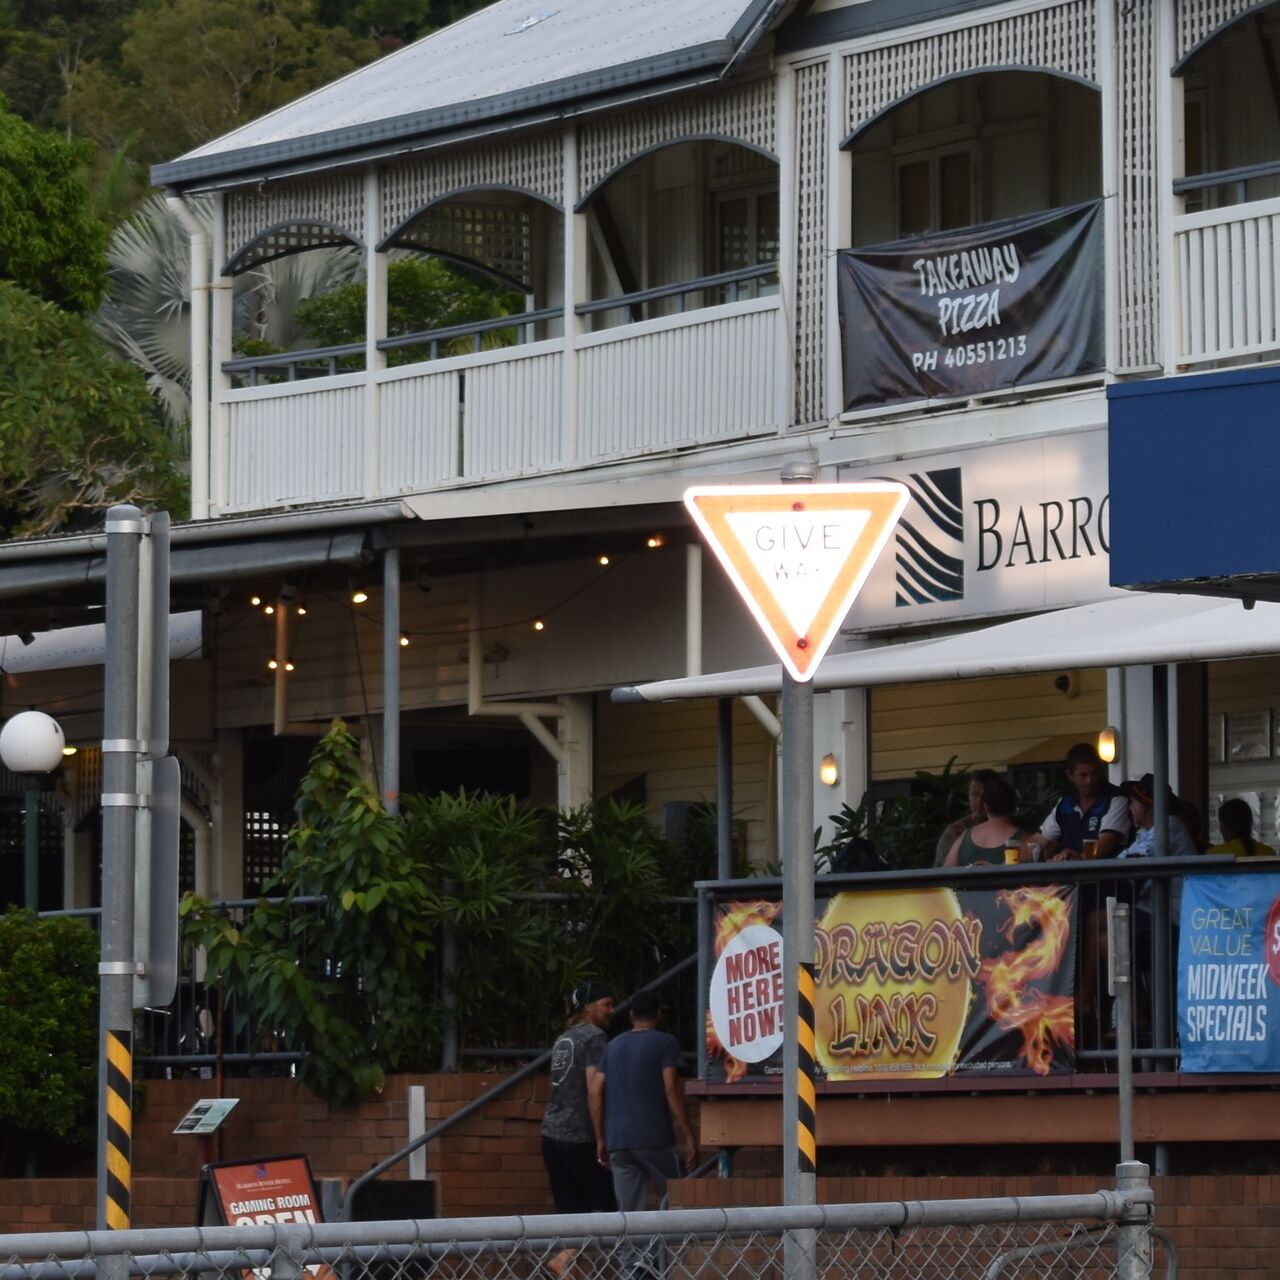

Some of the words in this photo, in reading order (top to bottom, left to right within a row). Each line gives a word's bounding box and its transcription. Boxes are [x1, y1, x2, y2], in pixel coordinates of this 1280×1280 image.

[912, 243, 1020, 297] TAKEAWAY
[938, 288, 1001, 337] PIZZA
[912, 350, 938, 373] PH
[944, 334, 1027, 369] 40551213
[755, 524, 841, 552] GIVE
[1191, 907, 1253, 930] GREAT
[725, 941, 781, 985] MORE
[1190, 935, 1252, 956] VALUE
[727, 972, 783, 1017] HERE
[1187, 963, 1270, 1001] MIDWEEK
[729, 1007, 783, 1047] NOW!
[828, 993, 937, 1058] LINK
[1187, 1005, 1268, 1042] SPECIALS
[230, 1198, 276, 1215] GAMING
[276, 1194, 311, 1209] ROOM
